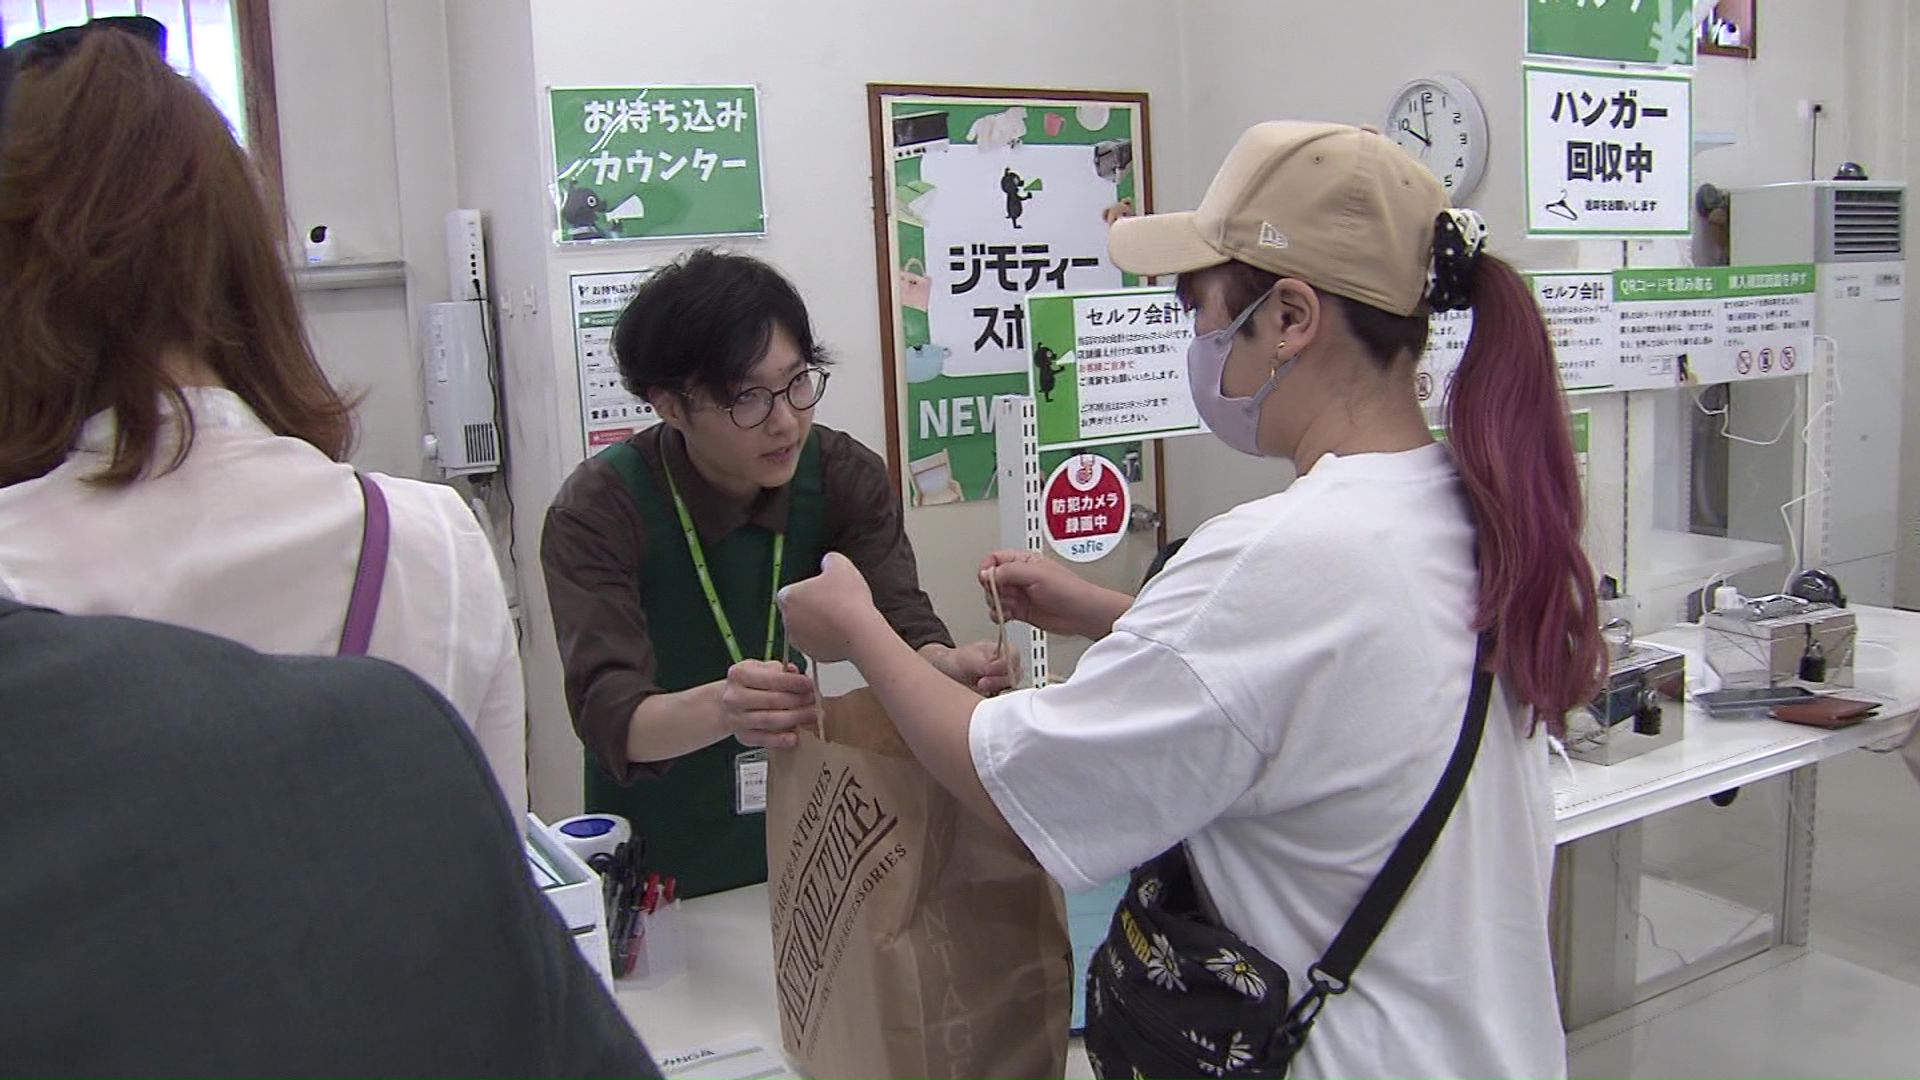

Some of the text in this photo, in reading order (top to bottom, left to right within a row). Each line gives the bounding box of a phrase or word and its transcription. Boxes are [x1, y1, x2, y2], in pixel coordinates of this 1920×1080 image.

[584, 99, 748, 133] お持ち込み
[1408, 100, 1417, 113] 11
[1452, 112, 1461, 124] 2
[1551, 90, 1668, 128] ハンガー
[1398, 118, 1410, 131] 10
[1459, 132, 1468, 145] 3
[592, 149, 747, 186] カウンター
[1454, 156, 1464, 168] 4
[1566, 140, 1652, 183] 回収中
[1443, 174, 1453, 187] 5
[949, 244, 1099, 295] ジモティー
[1542, 282, 1605, 300] セルフ会計
[1086, 303, 1182, 326] セルフ会計
[1051, 492, 1118, 515] 防犯カメラ
[789, 761, 832, 864] ANTIQUES
